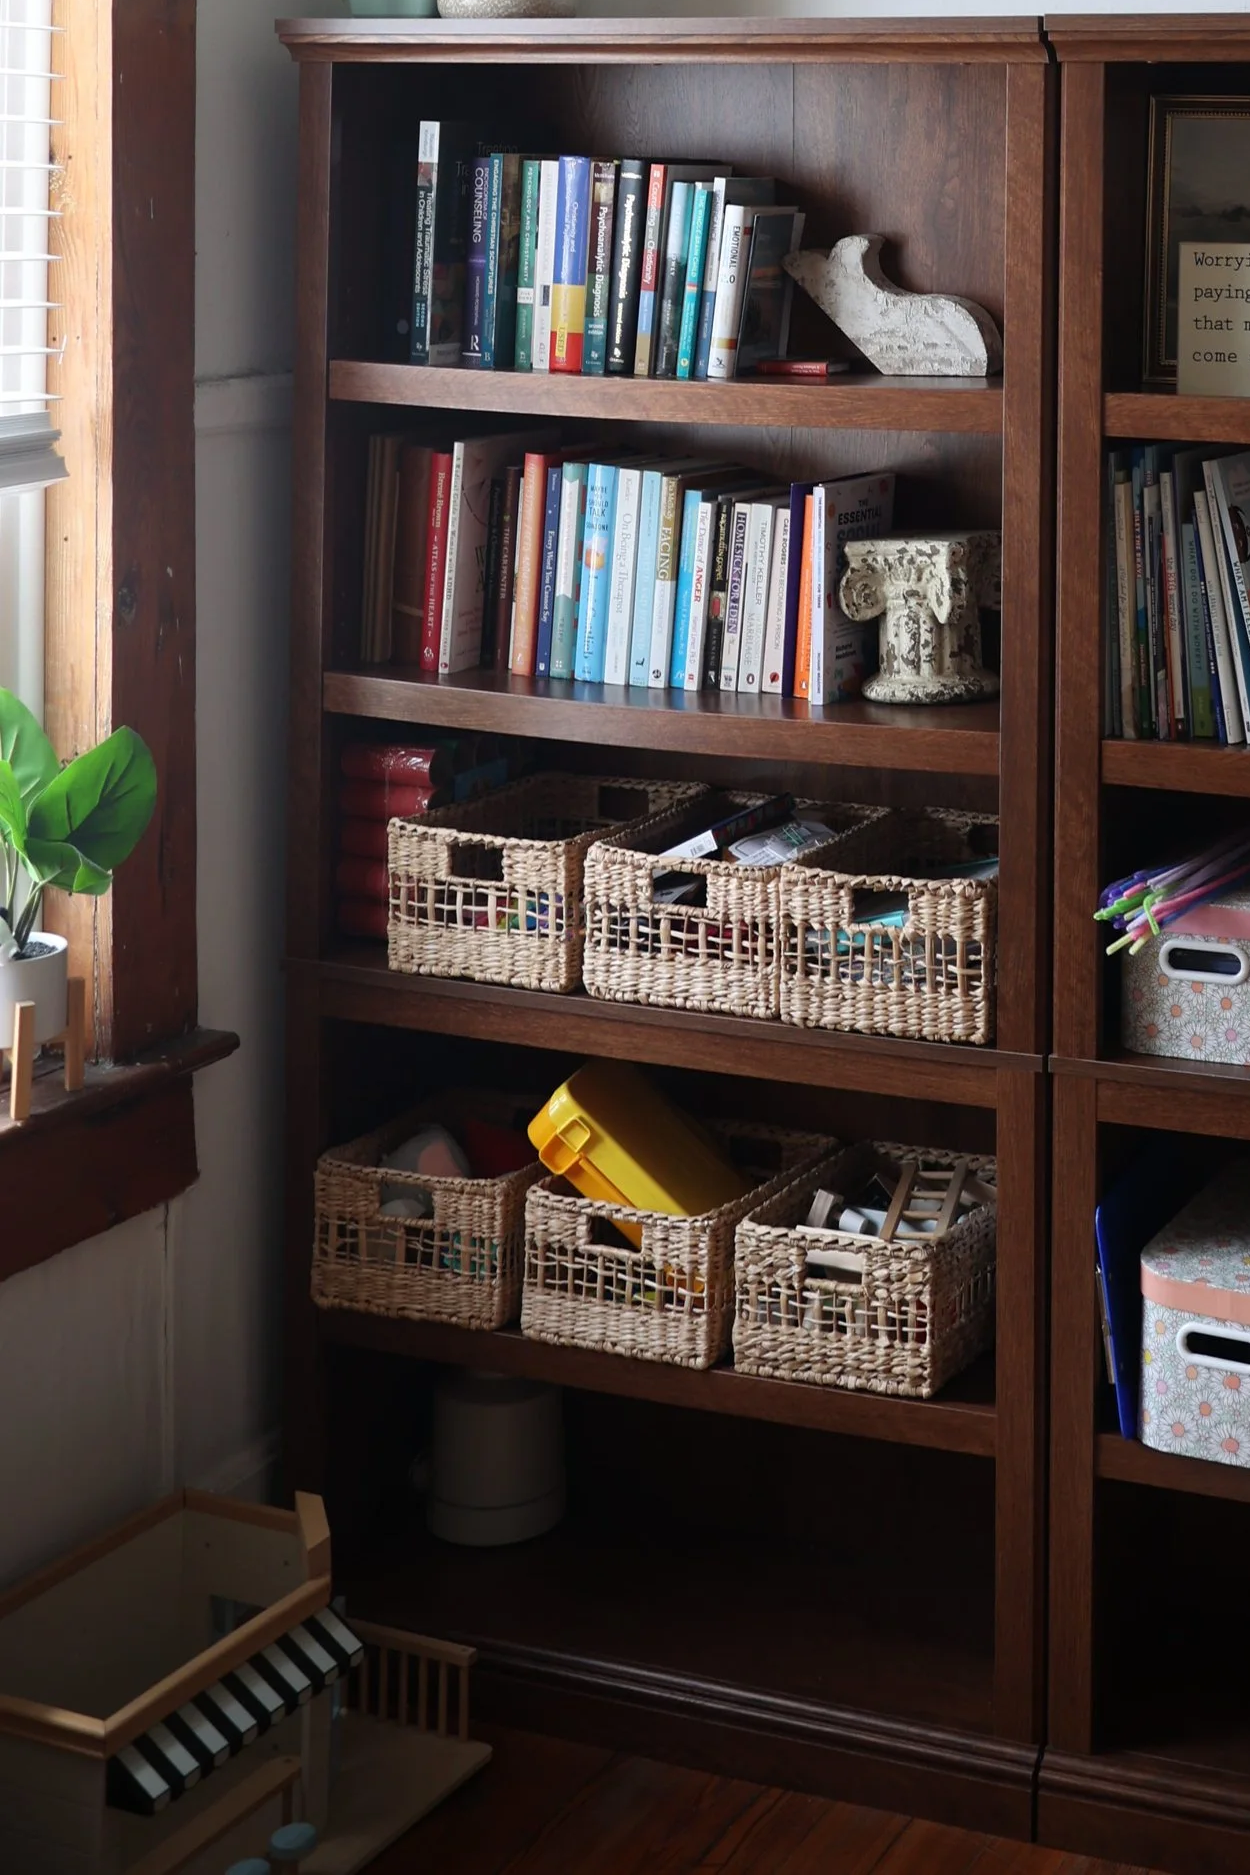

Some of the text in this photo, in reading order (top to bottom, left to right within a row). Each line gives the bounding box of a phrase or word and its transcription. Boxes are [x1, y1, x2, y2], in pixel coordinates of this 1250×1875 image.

[472, 167, 483, 243] COUNSELING
[525, 167, 533, 213] PSYCHOLOGY
[647, 182, 660, 226] Counseling
[417, 199, 425, 227] Children
[422, 192, 433, 295] Treating Traumatic Stress
[592, 206, 608, 317] Psychoanalytic Diagnosis
[643, 240, 655, 284] Christianity
[729, 226, 740, 269] EMOTIONAL
[415, 247, 423, 293] Adolescents
[615, 194, 635, 344] Psychoanalytic Diagnosis second edition
[557, 327, 566, 352] USED
[1193, 316, 1233, 331] that
[1192, 351, 1238, 363] come
[622, 513, 633, 530] On
[665, 495, 674, 521] Mellody
[838, 507, 882, 525] ESSENTIAL
[617, 532, 631, 561] Being
[658, 527, 672, 580] FACING
[693, 510, 708, 602] The Dance of ANGER
[755, 521, 767, 605] TIMOTHY KELLER
[780, 538, 788, 565] ROGERS
[499, 546, 509, 599] CARPENTER
[541, 530, 555, 623] Every Word You Cannot Say
[614, 570, 628, 613] Therapist
[727, 514, 747, 633] HOMESICK FOR EDEN
[779, 566, 786, 577] ON
[1233, 561, 1245, 587] WHAT
[777, 579, 785, 615] BECOMING
[1238, 590, 1248, 604] AM
[744, 613, 755, 666] MARRIAGE
